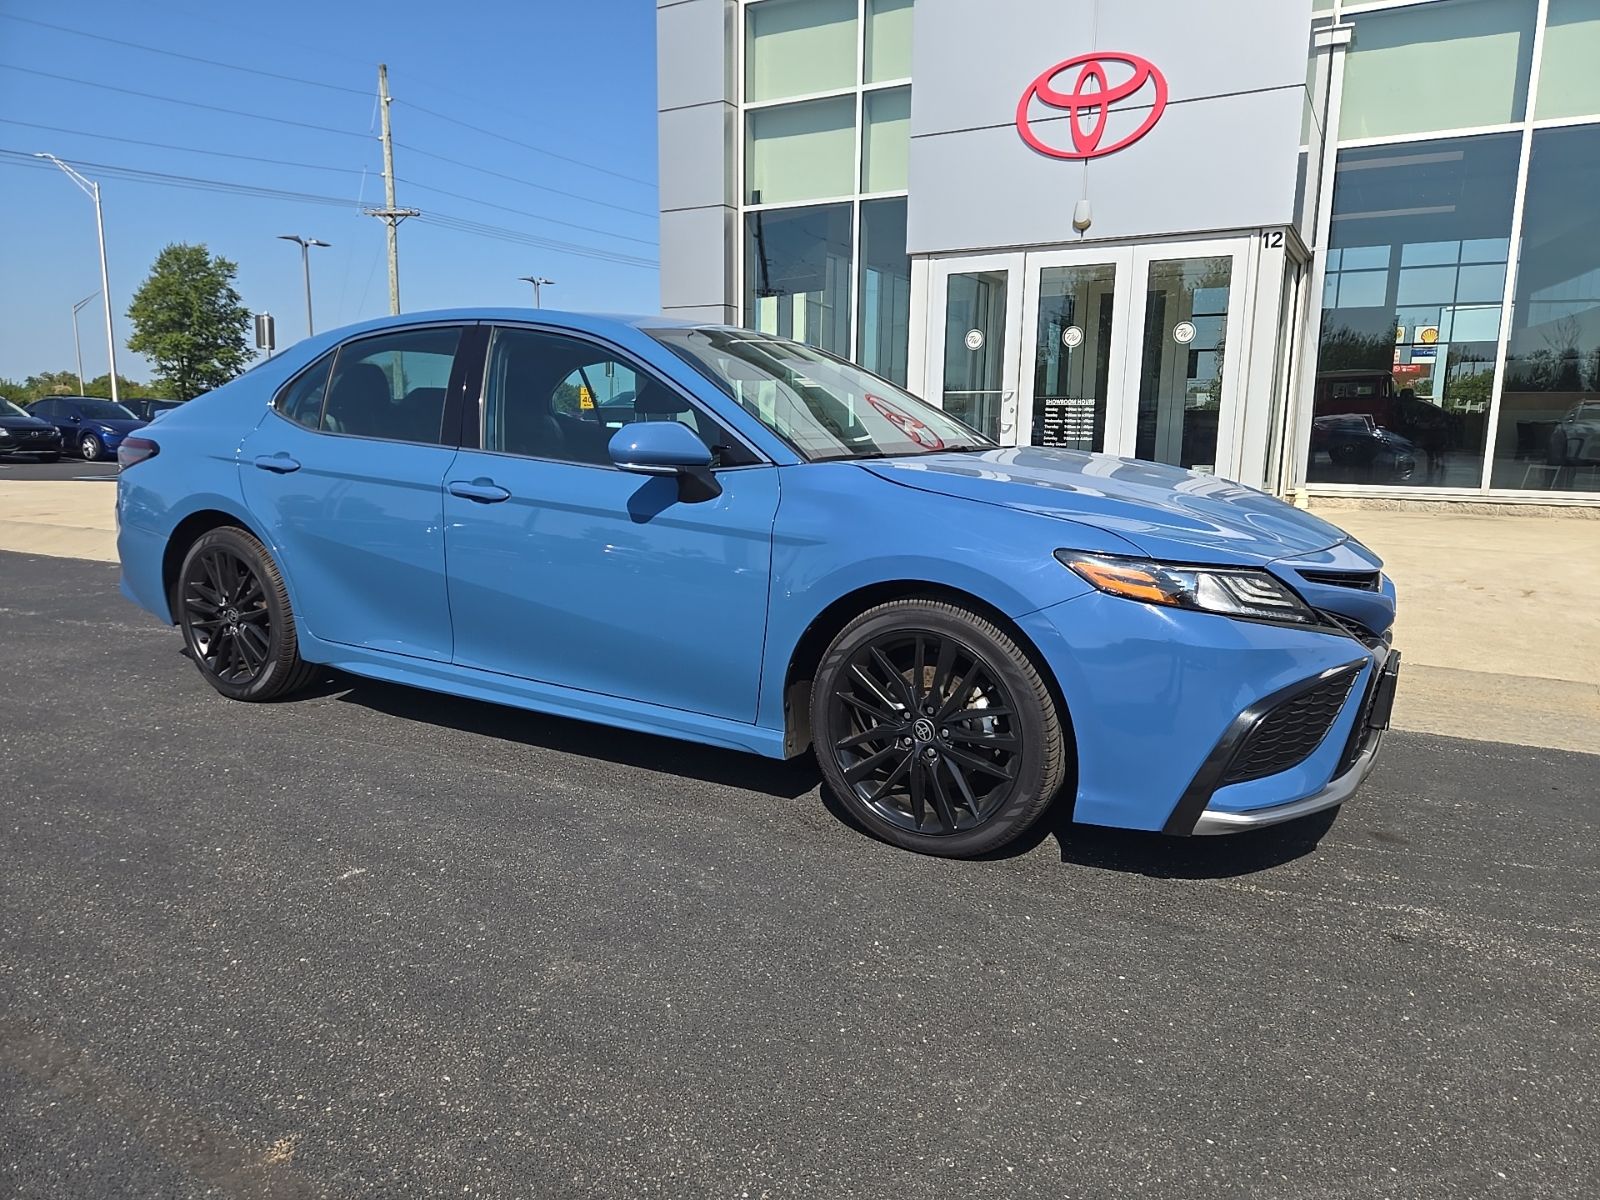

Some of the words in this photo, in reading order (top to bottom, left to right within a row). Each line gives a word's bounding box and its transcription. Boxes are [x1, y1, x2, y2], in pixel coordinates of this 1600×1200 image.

[1263, 232, 1283, 249] 12
[1045, 398, 1077, 406] SHOWROOM
[1078, 398, 1096, 406] HOURS
